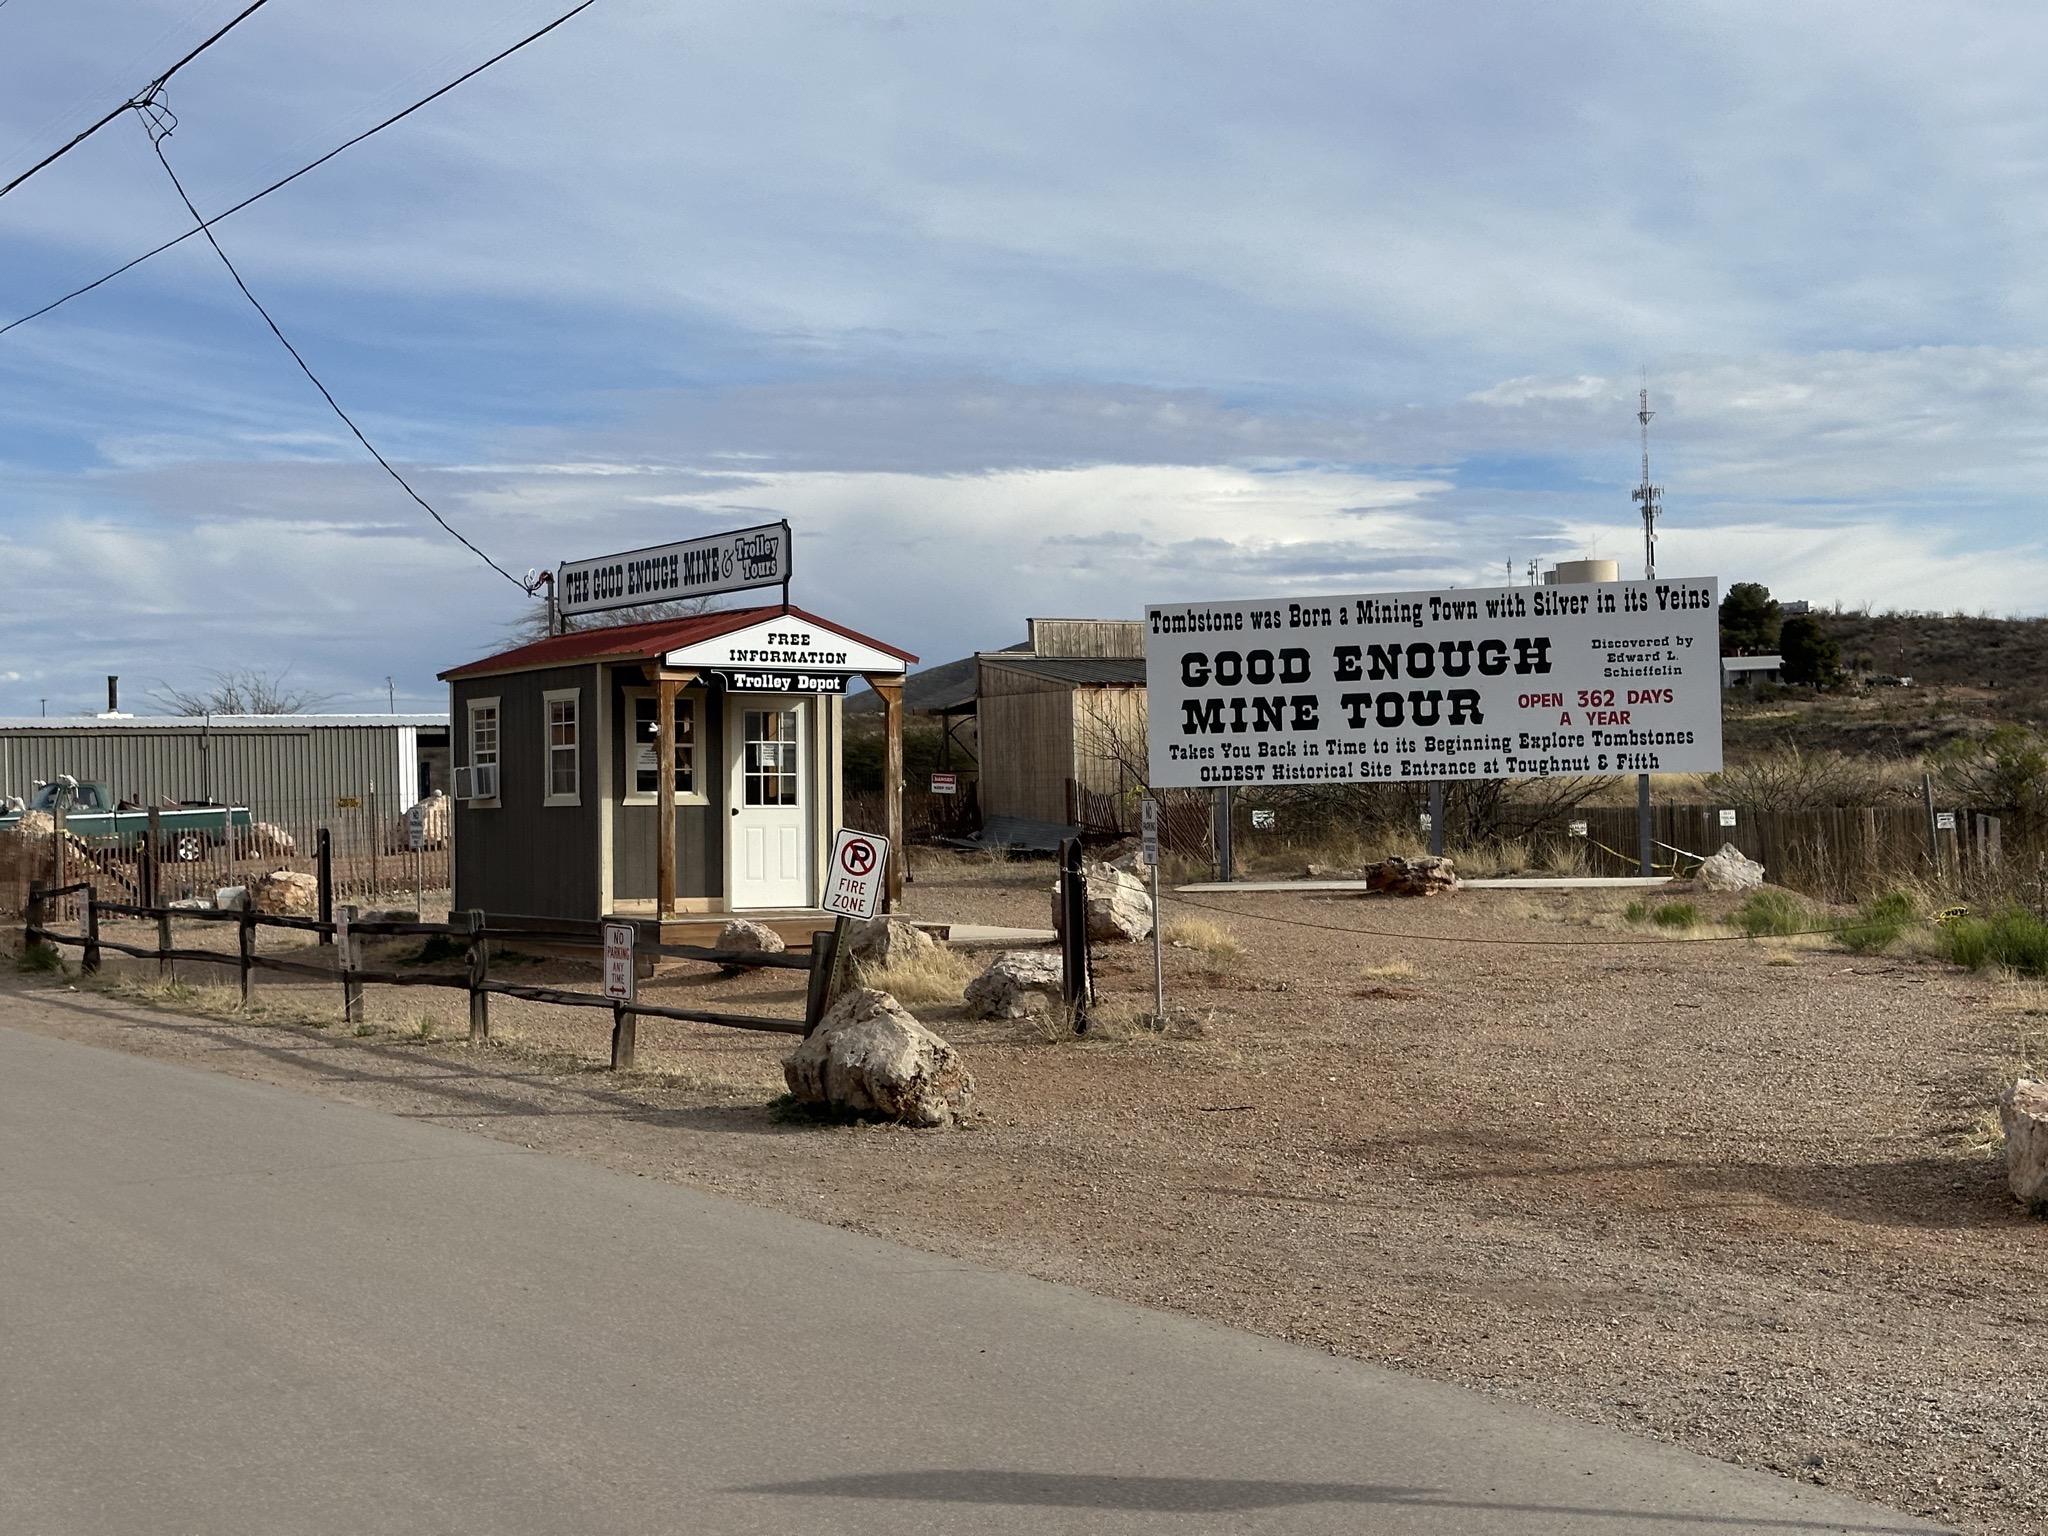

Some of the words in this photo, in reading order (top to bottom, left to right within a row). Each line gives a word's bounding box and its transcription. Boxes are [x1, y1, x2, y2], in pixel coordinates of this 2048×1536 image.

[735, 534, 778, 562] Trolley
[566, 570, 589, 604] THE
[593, 564, 623, 600] GOOD
[627, 554, 679, 595] ENOUGH
[684, 547, 719, 586] MINE
[722, 549, 734, 579] &
[743, 557, 778, 580] Tours
[1150, 609, 1243, 634] Tombstone
[1250, 610, 1281, 629] was
[1289, 604, 1332, 628] Born
[1339, 606, 1348, 625] a
[1356, 598, 1423, 628] Mining
[1430, 596, 1478, 621] Town
[1486, 592, 1526, 619] with
[1533, 590, 1589, 616] Silver
[1597, 588, 1616, 613] in
[1624, 587, 1648, 612] its
[1655, 584, 1711, 611] Veins
[767, 633, 811, 646] FREE
[1591, 636, 1669, 649] Discovered
[1676, 636, 1694, 648] by
[729, 649, 848, 665] INFORMATION
[1181, 648, 1311, 688] GOOD
[1333, 637, 1552, 683] ENOUGH
[1607, 651, 1661, 663] Edward
[1667, 651, 1679, 661] L.
[1604, 665, 1682, 678] Schieffelin
[734, 673, 791, 692] Trolley
[797, 675, 840, 692] Depot
[1518, 693, 1563, 708] OPEN
[1577, 689, 1615, 708] 362
[1627, 688, 1674, 705] DAYS
[1181, 695, 1320, 735] MINE
[1340, 688, 1484, 730] TOUR
[1560, 712, 1572, 726] A
[1586, 710, 1631, 726] YEAR
[1169, 743, 1215, 760] Takes
[1221, 743, 1250, 759] You
[1258, 741, 1296, 758] Back
[1303, 740, 1319, 757] in
[1326, 738, 1366, 756] Time
[1373, 738, 1389, 754] to
[1395, 737, 1416, 753] its
[1424, 734, 1512, 755] Beginning
[1519, 731, 1585, 752] Explore
[1591, 729, 1694, 747] Tombstones
[1200, 765, 1265, 782] OLDEST
[1272, 762, 1353, 780] Historical
[1360, 761, 1392, 778] Site
[1401, 758, 1476, 776] Entrance
[1484, 759, 1500, 774] at
[1506, 756, 1590, 776] Toughnut
[1597, 755, 1608, 770] &
[1617, 753, 1660, 770] Fifth
[1145, 805, 1152, 819] NO
[839, 878, 866, 896] FIRE
[832, 894, 865, 913] ZONE
[613, 931, 624, 945] NO
[608, 945, 629, 960] PARKING
[613, 961, 624, 973] ANY
[612, 973, 624, 985] TIME
